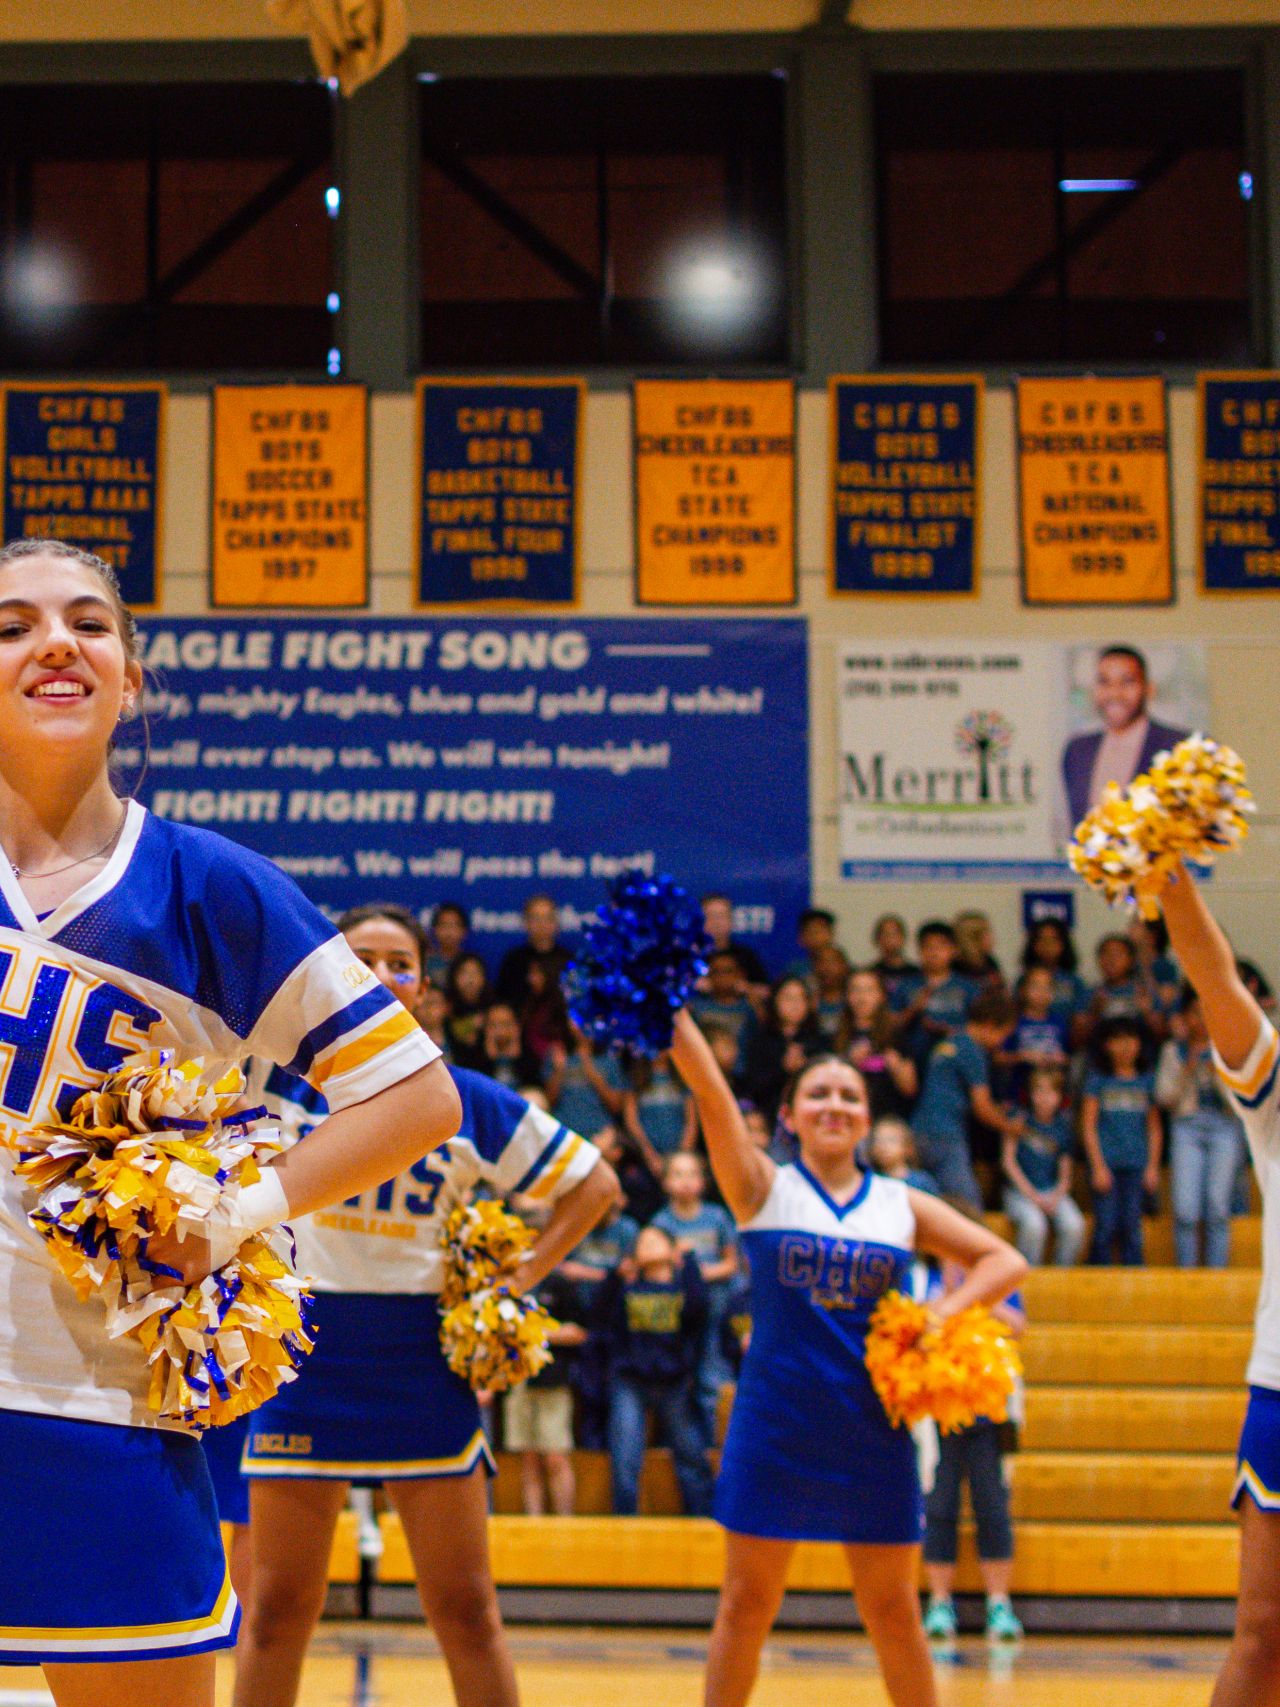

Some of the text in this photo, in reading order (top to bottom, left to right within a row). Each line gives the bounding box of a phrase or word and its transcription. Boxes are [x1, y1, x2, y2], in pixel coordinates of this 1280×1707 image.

[47, 426, 117, 452] GIRLS
[260, 439, 323, 462] BOYS
[467, 438, 532, 464] BOYS
[875, 432, 938, 459] BOYS
[10, 455, 151, 480] VOLLEYBALL
[246, 469, 334, 492] SOCCER
[837, 462, 974, 488] VOLLEYBALL
[427, 468, 569, 495] BASKETBALL
[10, 485, 85, 511] TAPPS
[219, 499, 363, 523] TAPPS STATE
[427, 498, 570, 524] TAPPS STATE
[679, 494, 751, 517] STATE
[837, 491, 904, 519] TAPPS
[1043, 492, 1146, 515] NATIONAL
[225, 528, 352, 551] CHAMPIONS
[431, 527, 564, 554] FINAL FOUR
[652, 524, 779, 547] CHAMPIONS
[849, 522, 958, 548] FINALIST
[1034, 521, 1160, 547] CHAMPIONS
[281, 630, 431, 671] FIGHT
[438, 630, 590, 671] SONG
[198, 686, 300, 720] mighty
[303, 687, 404, 720] Eagles,
[409, 686, 472, 714] blue
[477, 685, 536, 714] and
[539, 685, 606, 721] gold
[610, 685, 668, 714] and
[673, 685, 763, 714] white!
[148, 739, 200, 768] will
[202, 747, 267, 768] ever
[272, 742, 335, 774] stop
[339, 747, 382, 768] us.
[387, 740, 436, 768] We
[441, 739, 495, 768] will
[498, 739, 552, 768] win
[557, 740, 670, 776] tonight!
[844, 751, 1038, 801] Merritt
[355, 849, 403, 877] We
[409, 849, 462, 877] will
[465, 855, 533, 884] pass
[538, 849, 586, 877] the
[254, 1434, 312, 1453] EAGLES
